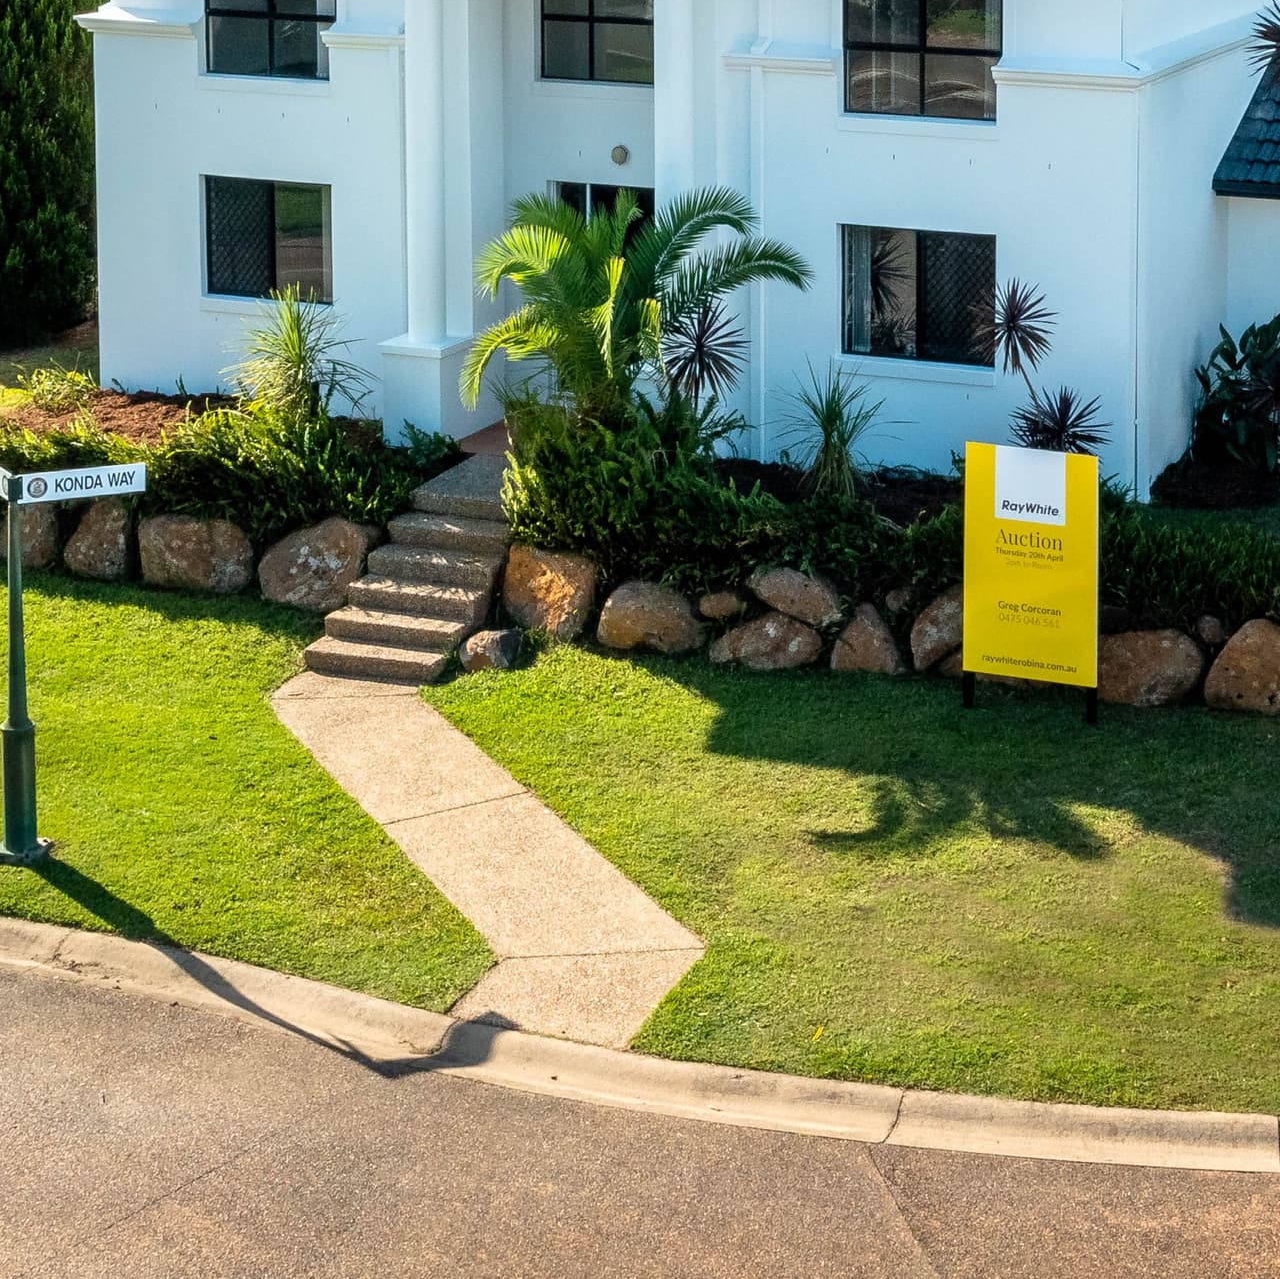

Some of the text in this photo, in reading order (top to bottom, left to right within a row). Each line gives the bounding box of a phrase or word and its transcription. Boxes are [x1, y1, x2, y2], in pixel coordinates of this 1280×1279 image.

[55, 471, 136, 492] KONDA WAY
[1001, 500, 1059, 516] RayWhite
[995, 529, 1062, 551] Auction
[995, 547, 1064, 562] Thursday 20th April
[998, 601, 1061, 616] Greg Corcoran
[982, 654, 1077, 673] raywhiterobina.com.au
